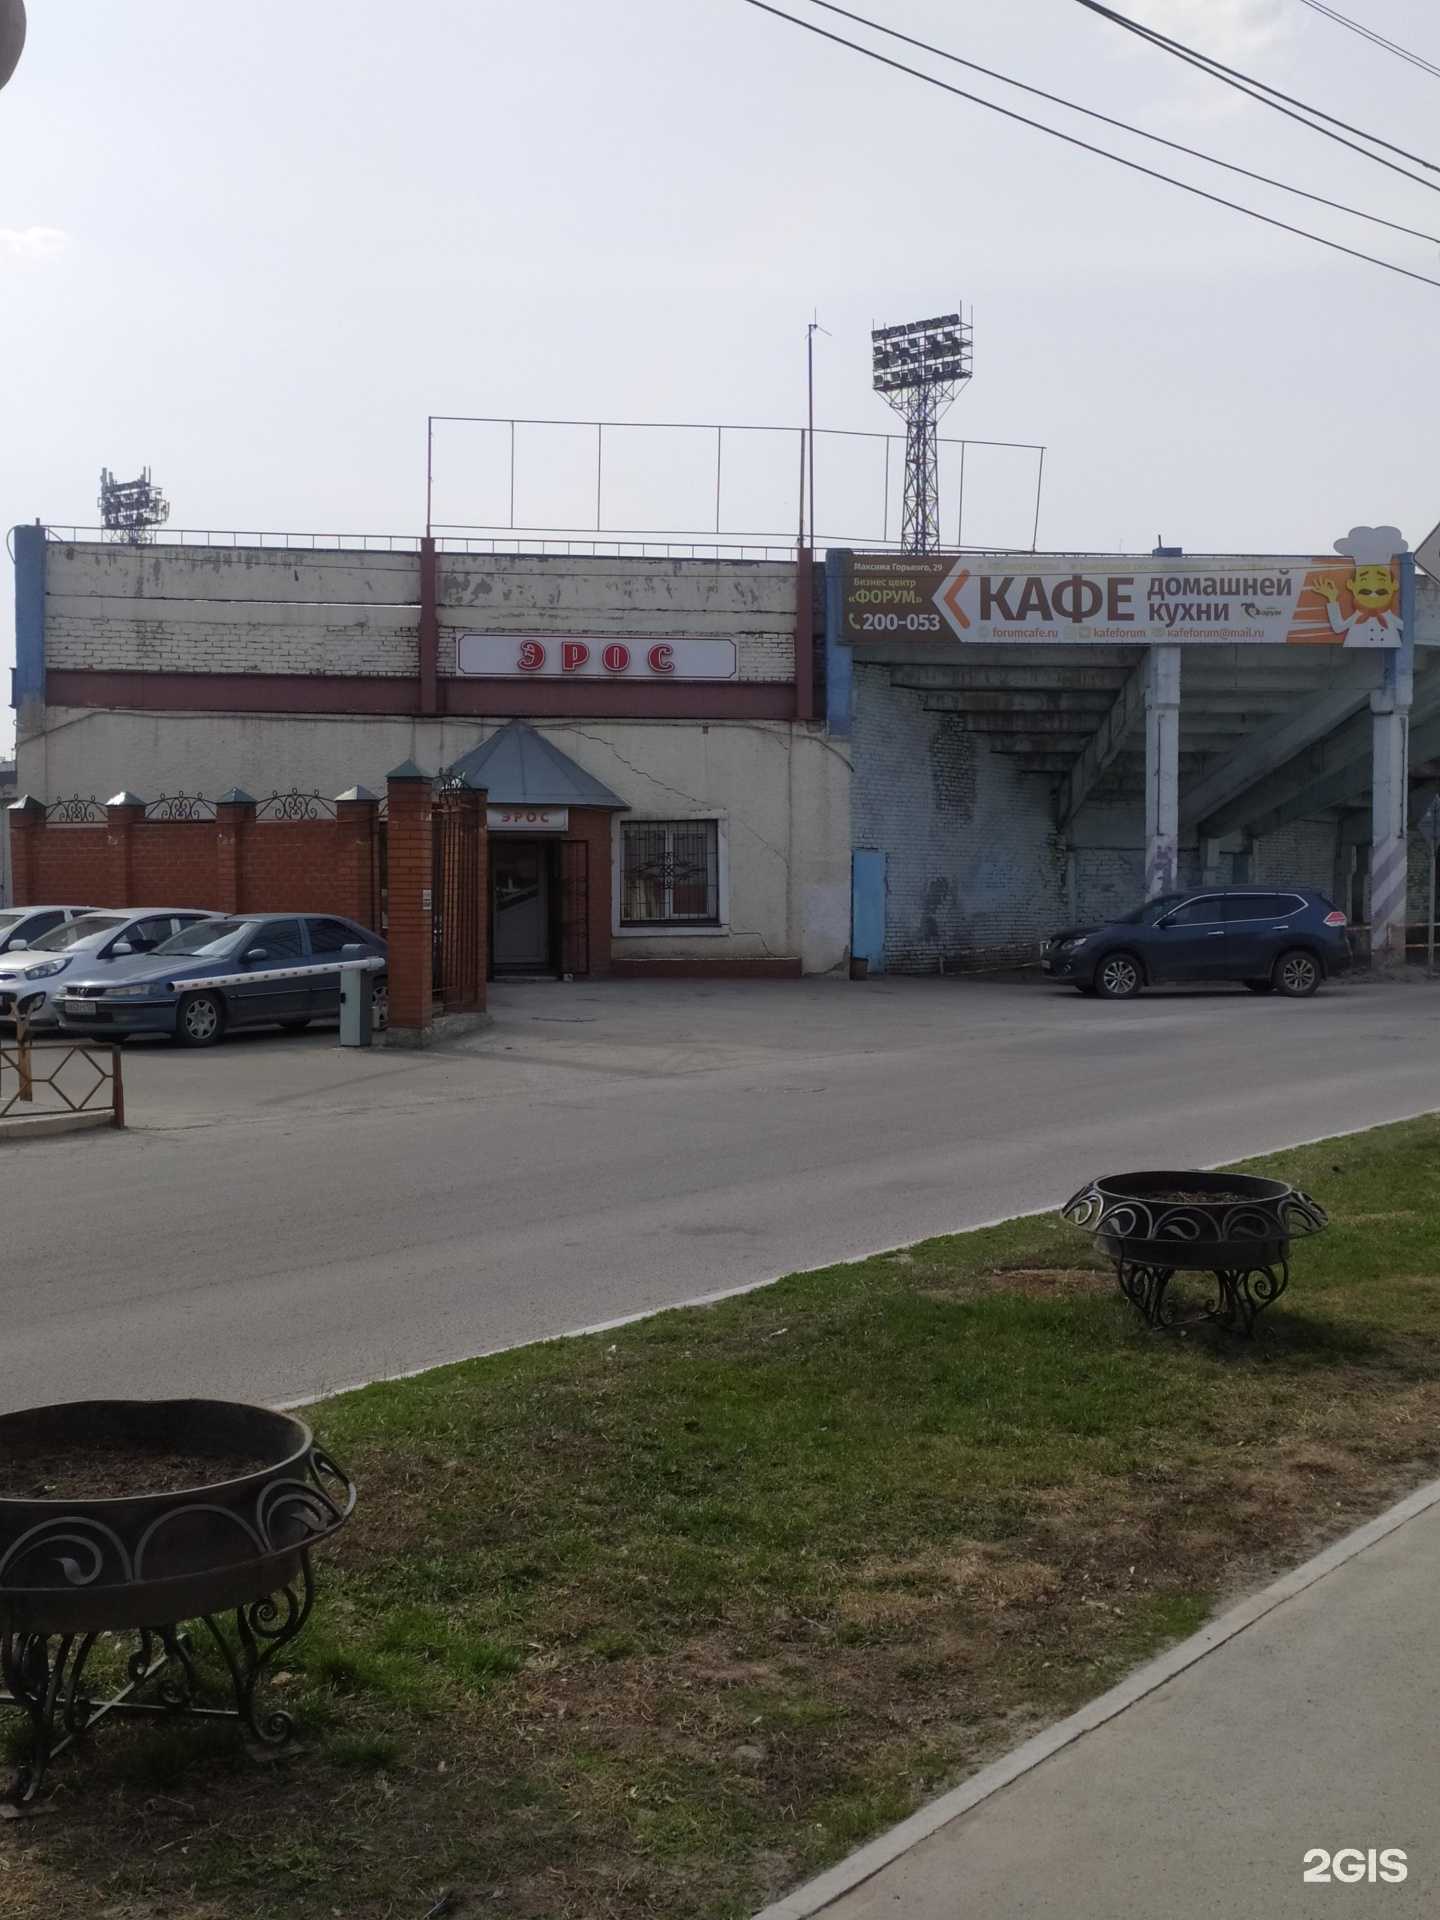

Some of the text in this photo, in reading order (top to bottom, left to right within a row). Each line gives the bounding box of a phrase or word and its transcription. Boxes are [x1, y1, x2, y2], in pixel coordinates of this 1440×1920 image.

[932, 563, 943, 571] 29
[1147, 569, 1292, 601] домашней
[848, 589, 922, 604] «ФОРУМ»
[980, 575, 1135, 623] КАФЕ
[863, 613, 940, 631] 200-053
[1149, 602, 1229, 628] кухни
[992, 627, 1058, 638] forumcafe.ru
[1093, 627, 1146, 638] kafeforum
[1168, 628, 1264, 639] kafeforum@mail.ru
[517, 639, 675, 673] ЭРОС
[501, 811, 549, 823] ЭРОС
